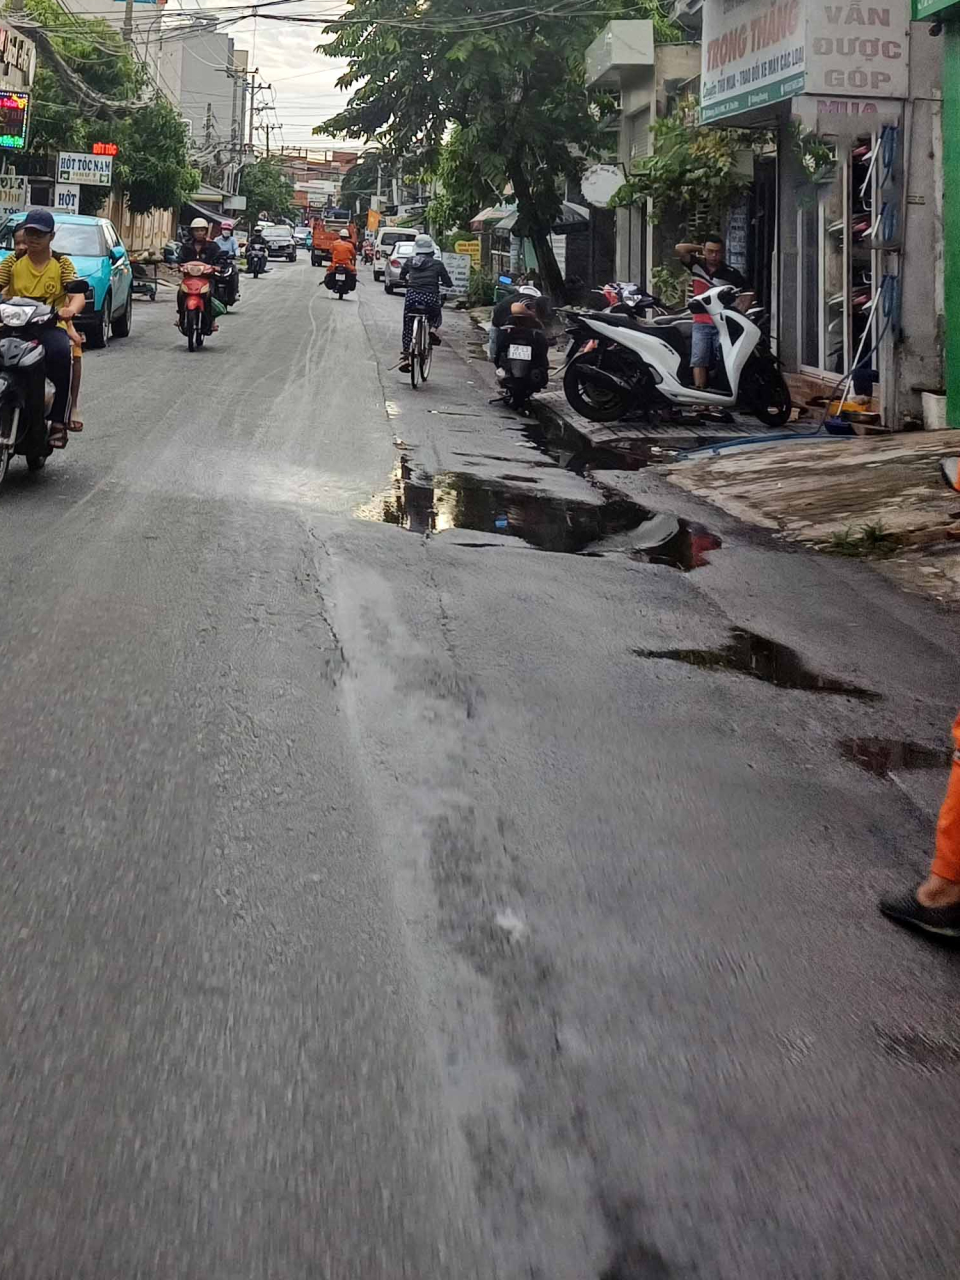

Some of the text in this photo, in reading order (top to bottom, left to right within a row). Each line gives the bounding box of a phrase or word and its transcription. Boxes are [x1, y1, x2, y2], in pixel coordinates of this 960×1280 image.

[824, 0, 891, 27] VẪN
[707, 22, 748, 76] TRỌNG
[812, 36, 902, 62] ĐƯỢC
[825, 66, 891, 90] GÓP
[77, 156, 93, 171] TÓC
[93, 160, 111, 172] NAM
